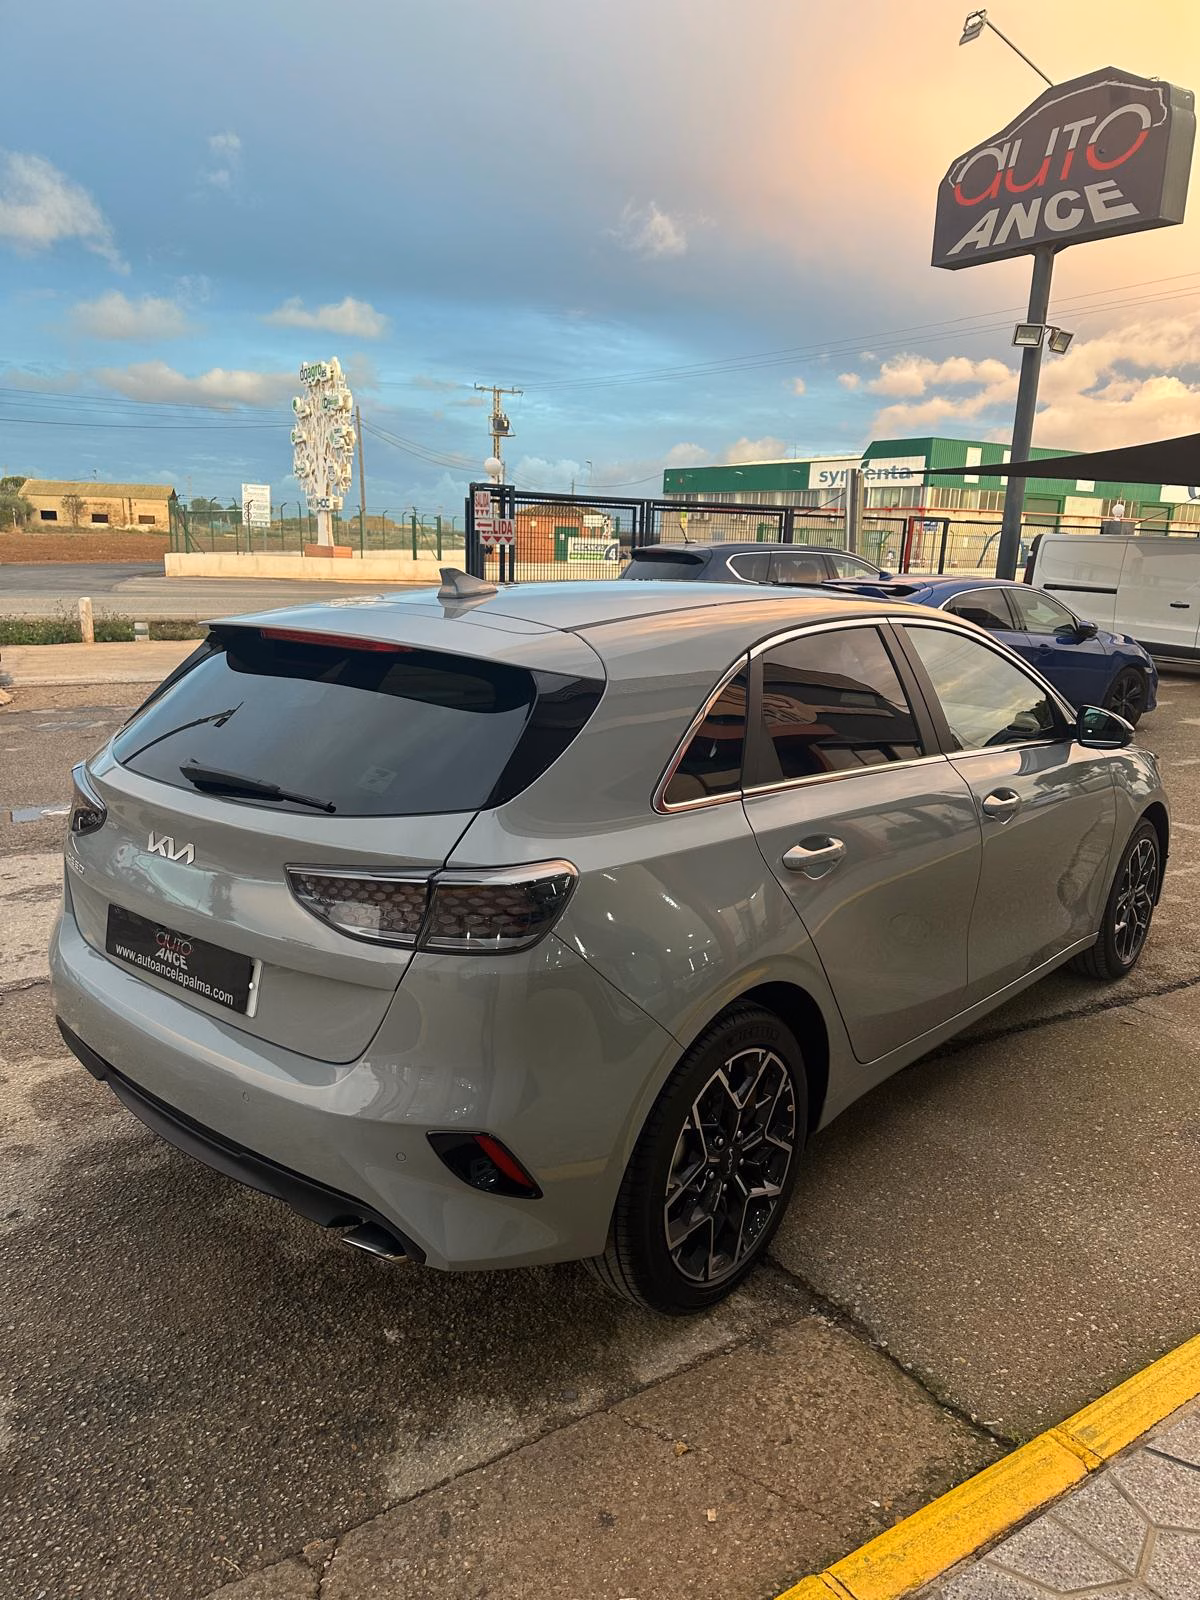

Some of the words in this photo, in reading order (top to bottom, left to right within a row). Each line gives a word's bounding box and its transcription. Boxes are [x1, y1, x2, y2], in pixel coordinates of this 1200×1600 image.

[946, 179, 1140, 255] ANCE
[818, 464, 911, 487] synenta
[481, 520, 513, 535] LIDA
[147, 831, 196, 865] KIA
[155, 947, 188, 970] ANCE
[115, 943, 234, 1006] www.autoancelapalma.com
